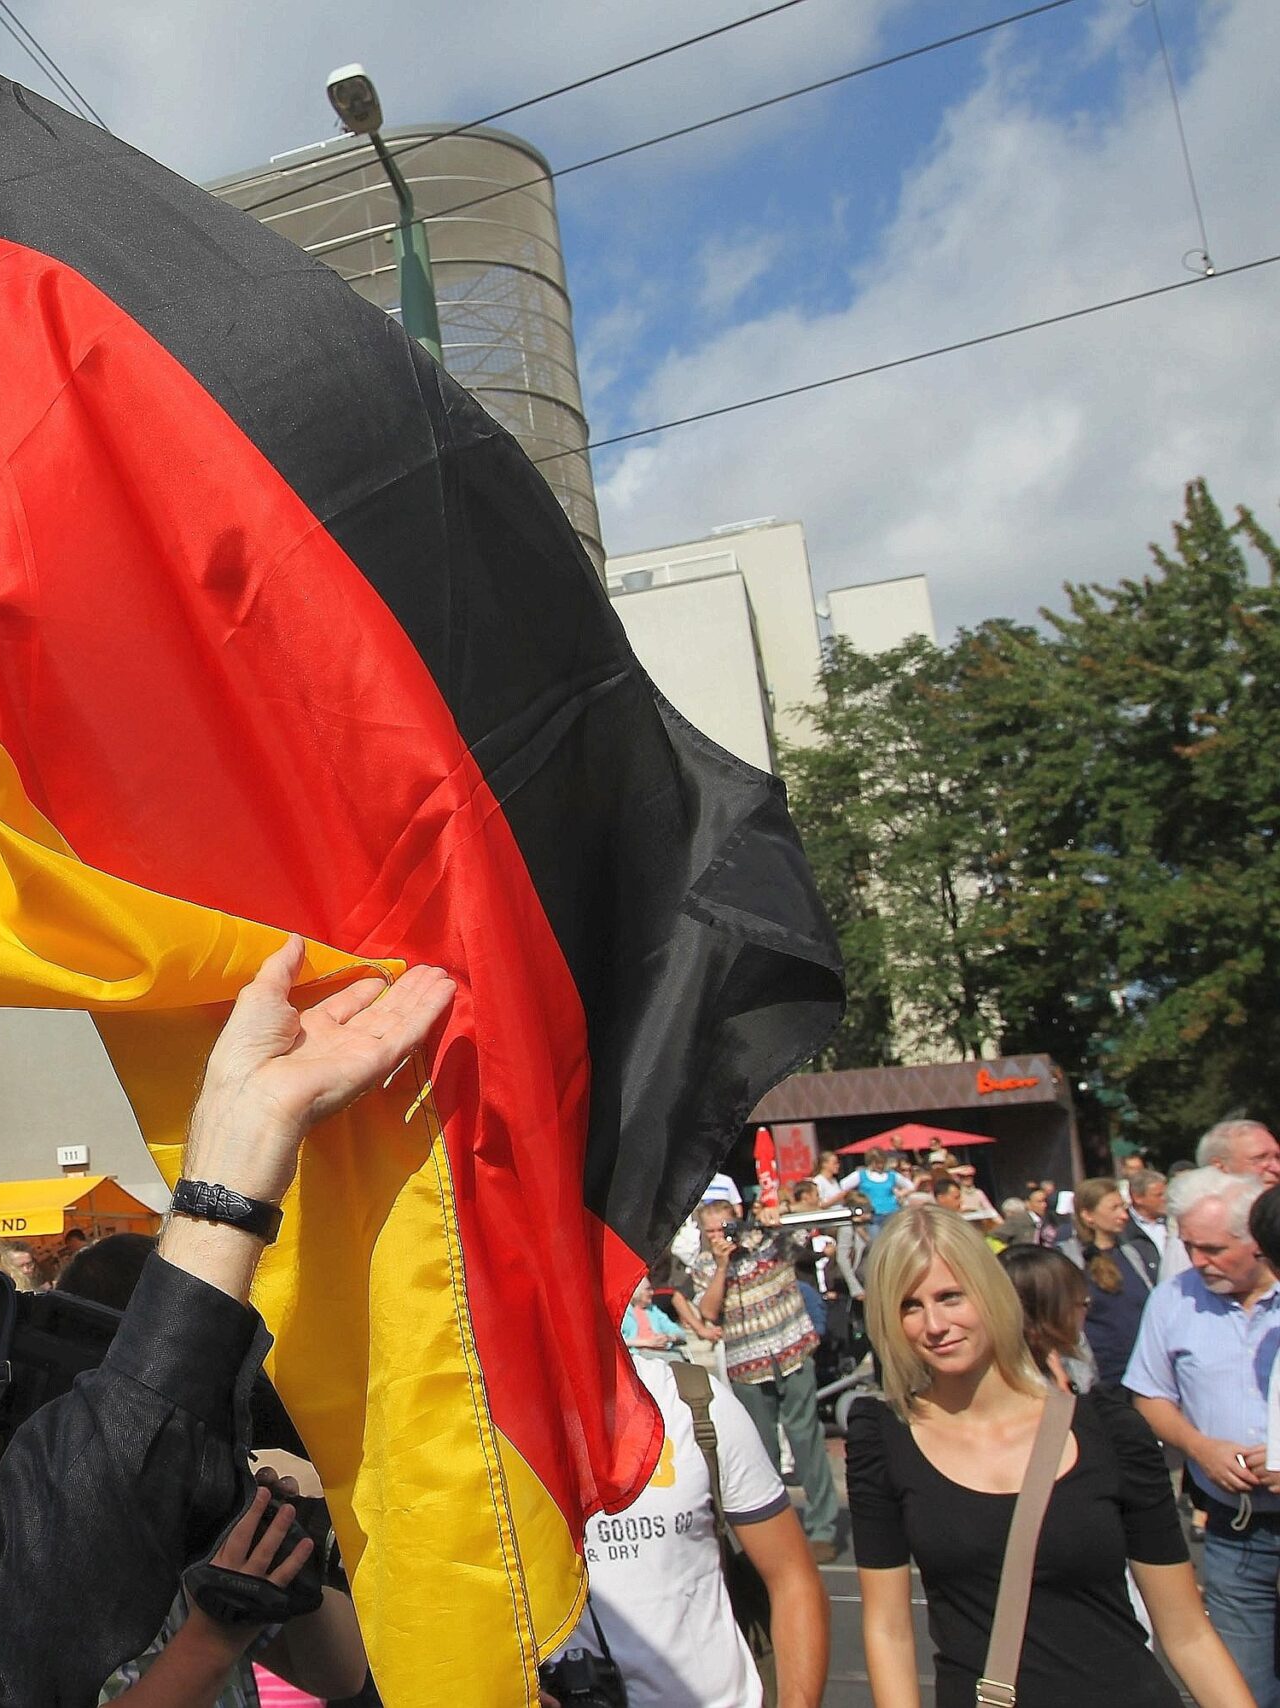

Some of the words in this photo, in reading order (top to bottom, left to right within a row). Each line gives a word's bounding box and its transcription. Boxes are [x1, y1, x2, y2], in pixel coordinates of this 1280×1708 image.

[597, 1515, 666, 1543] GOODS
[587, 1548, 600, 1562] &
[608, 1544, 639, 1561] DRY
